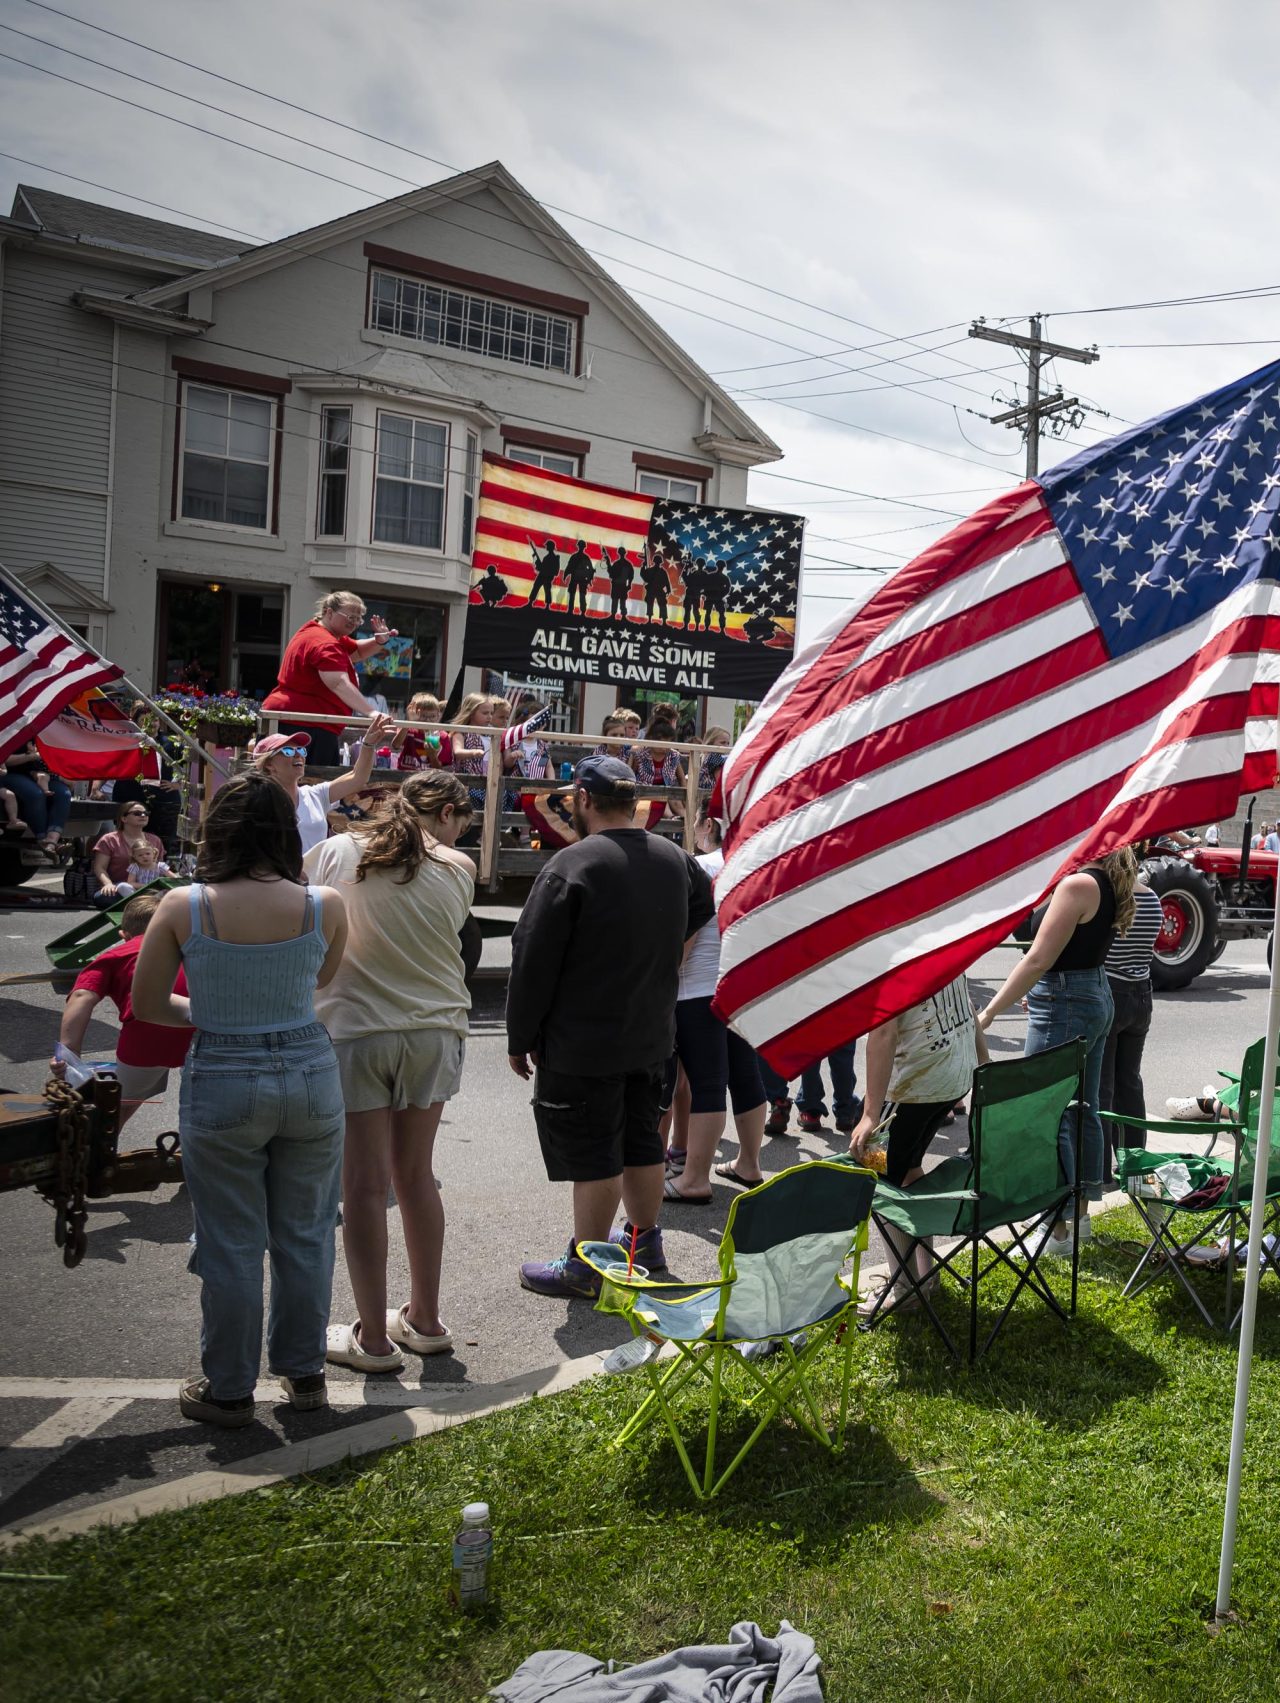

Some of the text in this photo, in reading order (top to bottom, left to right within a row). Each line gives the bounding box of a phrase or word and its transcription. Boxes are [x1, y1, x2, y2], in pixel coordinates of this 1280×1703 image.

[531, 628, 716, 669] ALL GAVE SOME
[530, 651, 600, 676] SOME
[608, 662, 666, 685] GAVE
[675, 671, 714, 690] ALL
